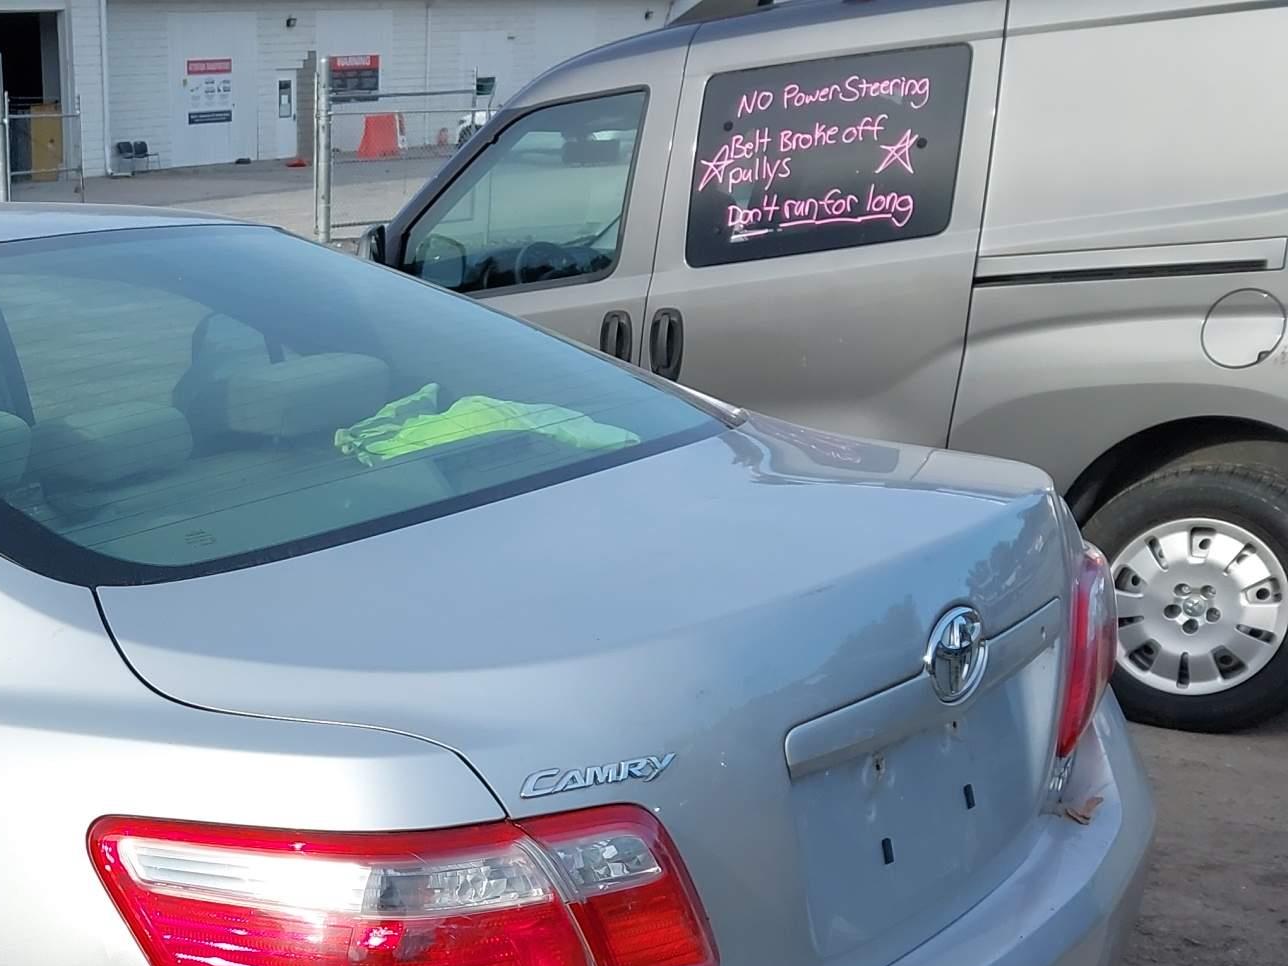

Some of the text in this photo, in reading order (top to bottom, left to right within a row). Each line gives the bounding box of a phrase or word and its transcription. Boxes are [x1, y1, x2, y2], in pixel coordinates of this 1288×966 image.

[780, 123, 838, 153] Broke
[842, 114, 888, 143] off
[866, 184, 913, 227] long
[520, 752, 677, 799] CAMRY
